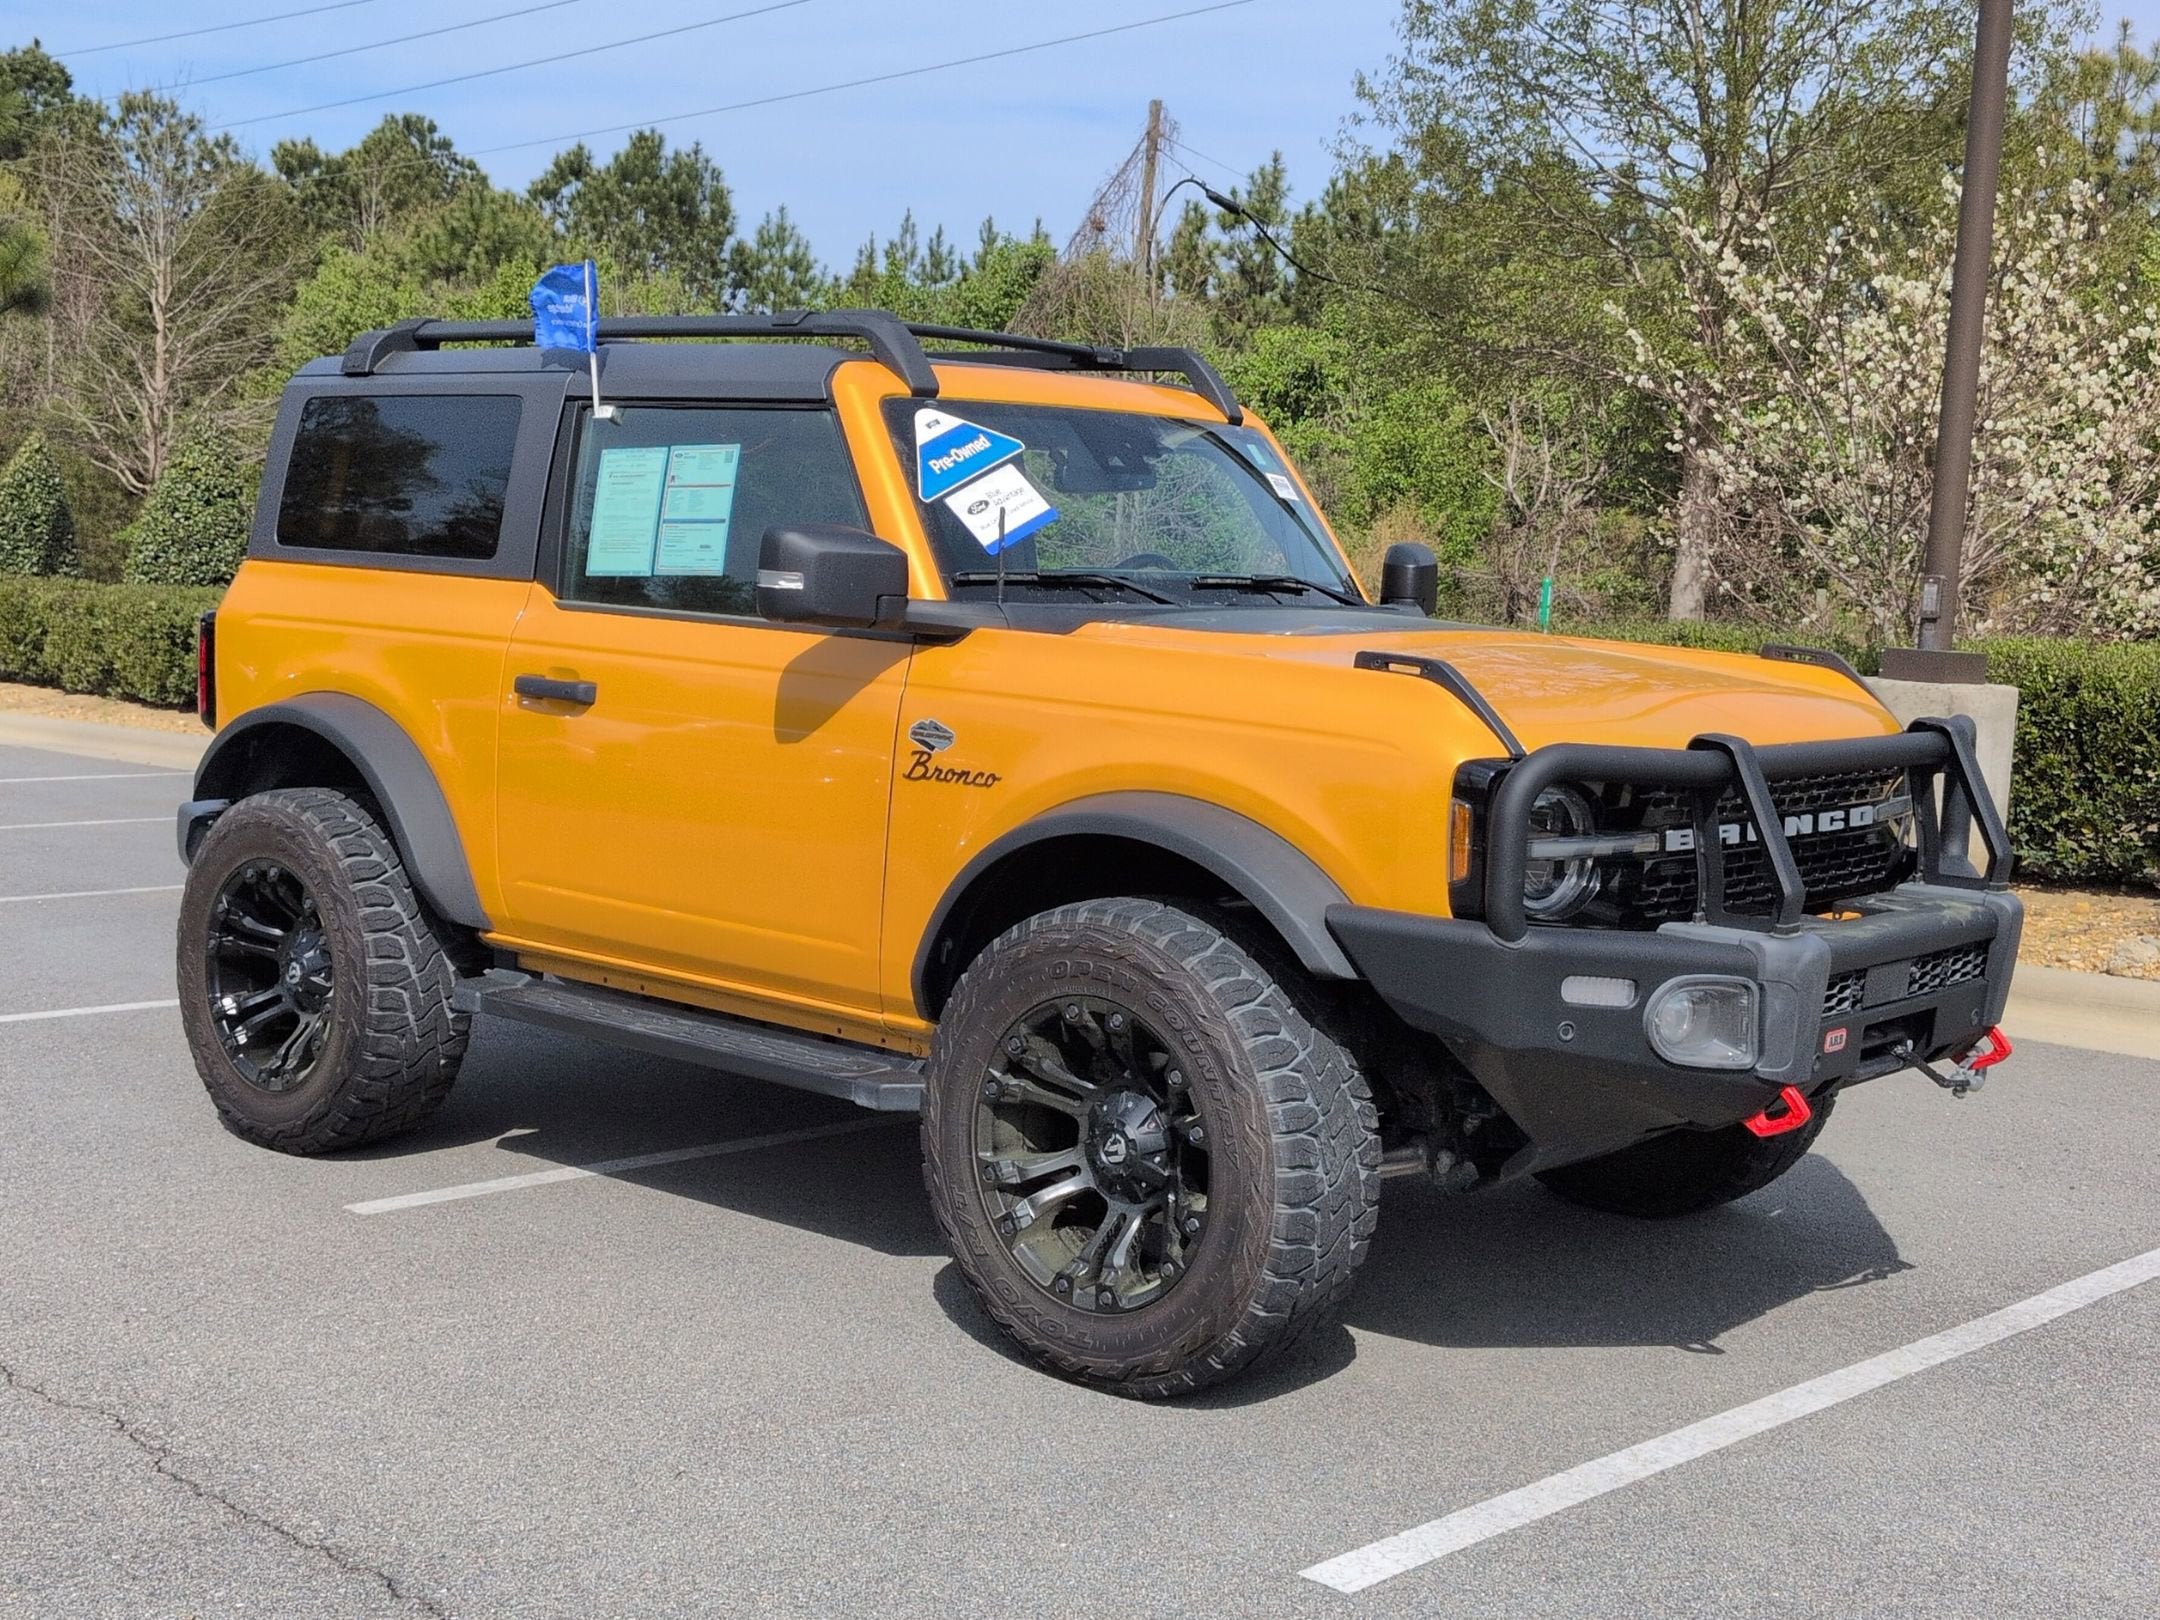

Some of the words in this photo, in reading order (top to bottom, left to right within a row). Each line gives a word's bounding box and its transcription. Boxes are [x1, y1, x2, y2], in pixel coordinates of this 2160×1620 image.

[928, 434, 992, 474] Pre-Owned
[903, 750, 1002, 788] Bronco
[1049, 959, 1139, 993] OPEN
[993, 1276, 1093, 1350] TOYO
